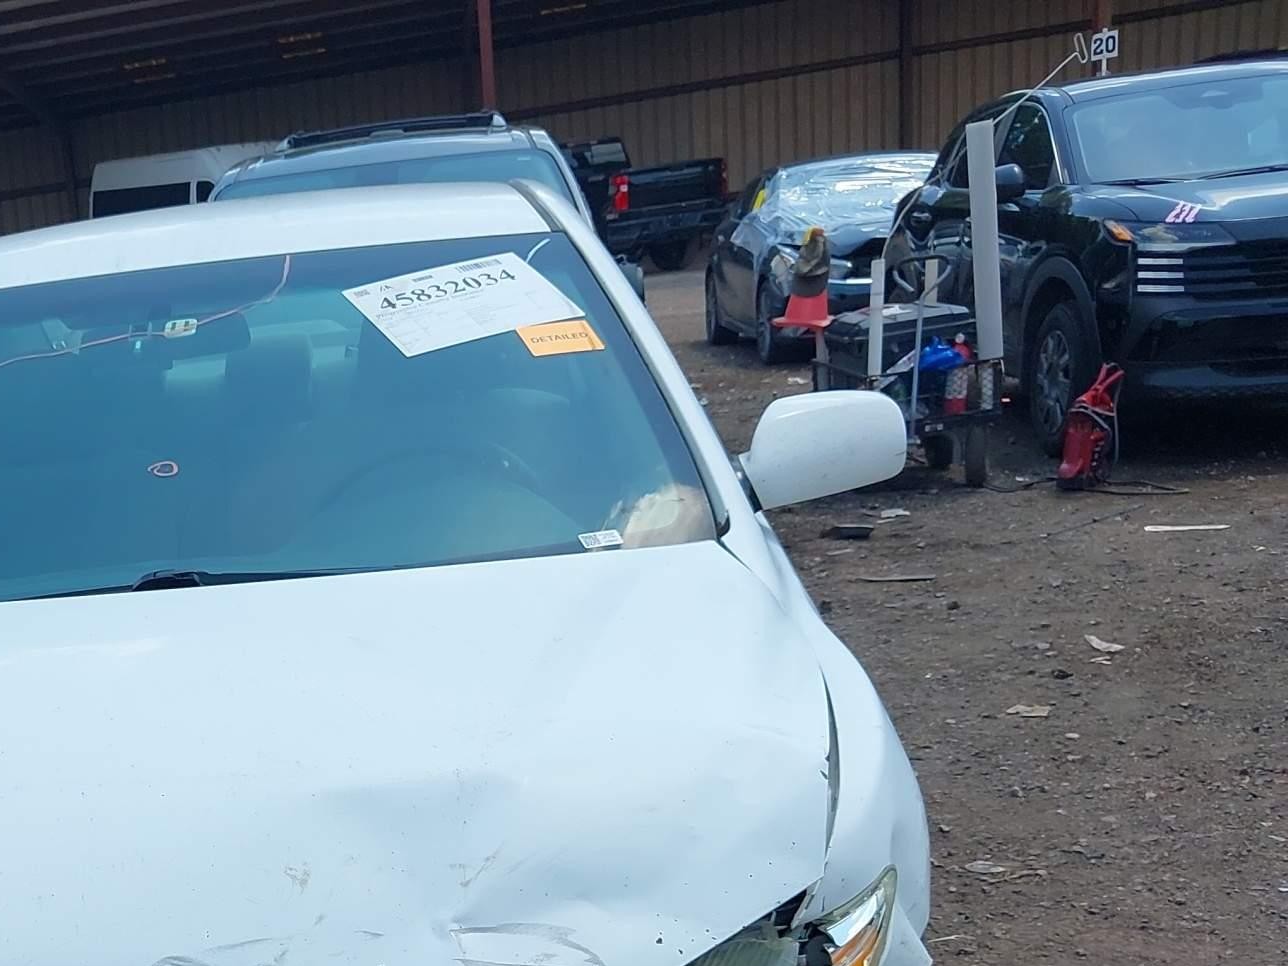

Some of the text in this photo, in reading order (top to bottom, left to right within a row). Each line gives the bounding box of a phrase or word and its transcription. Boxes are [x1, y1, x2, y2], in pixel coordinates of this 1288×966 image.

[1093, 35, 1116, 56] 20
[380, 268, 517, 309] 45832034
[530, 332, 589, 344] DETAILED
